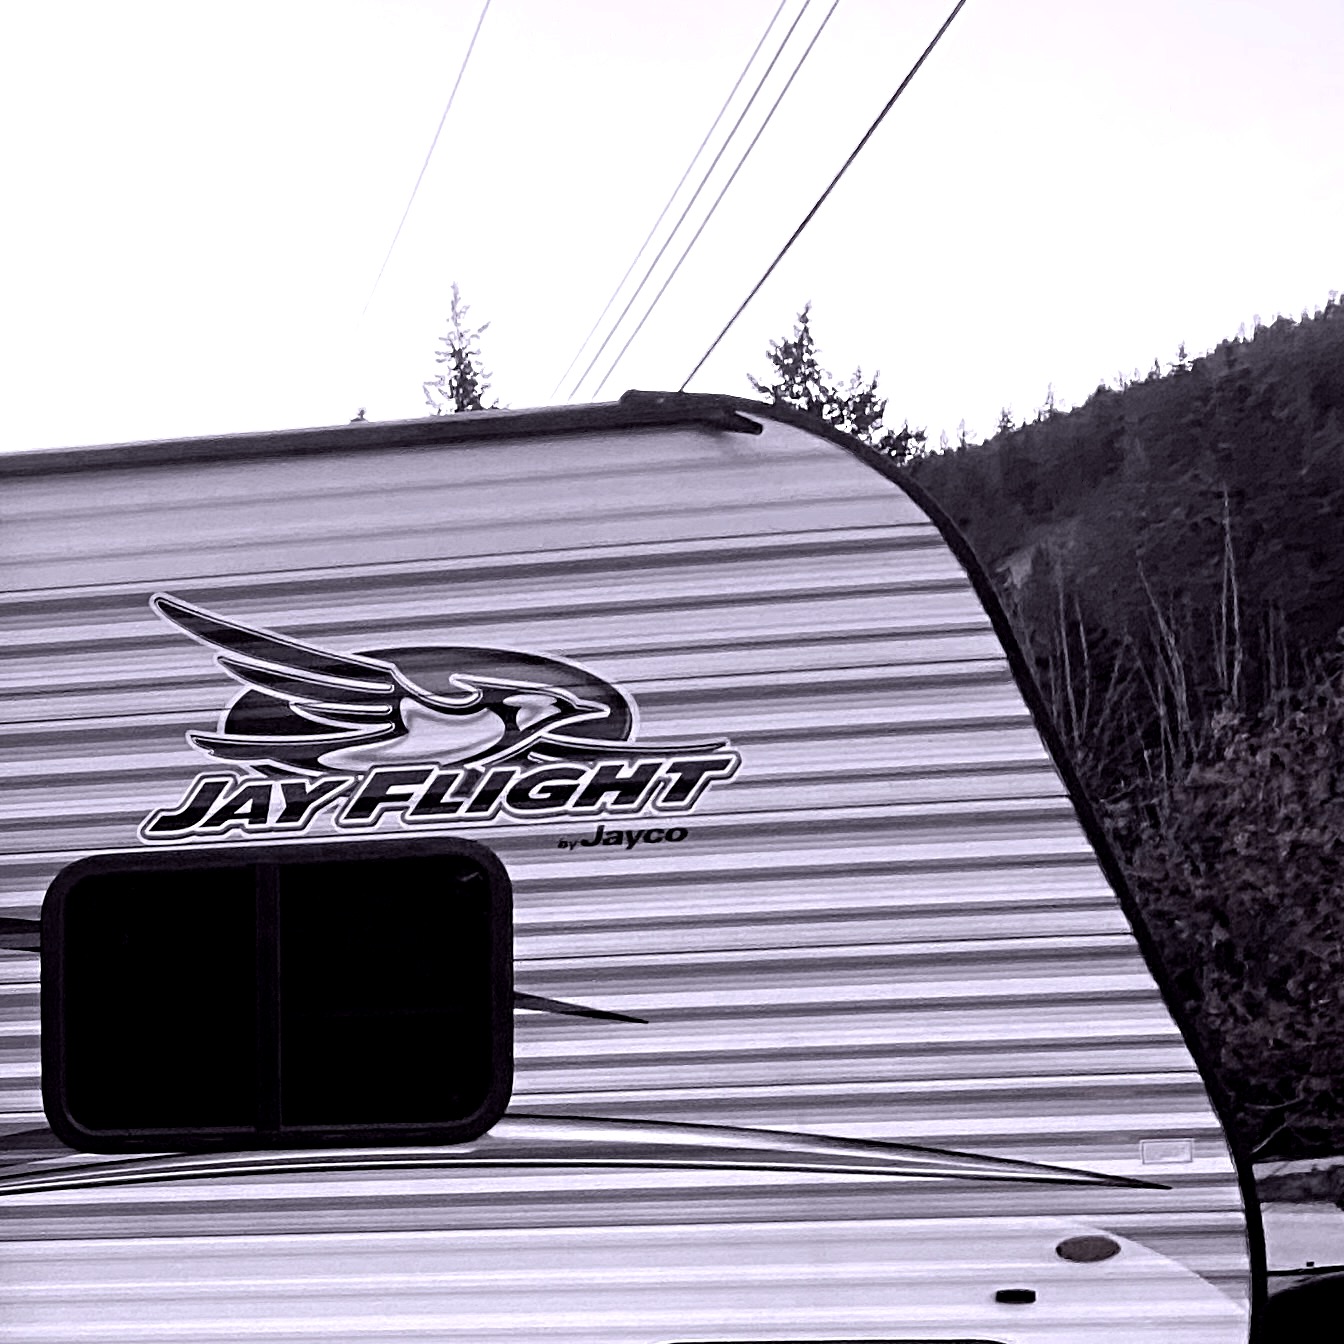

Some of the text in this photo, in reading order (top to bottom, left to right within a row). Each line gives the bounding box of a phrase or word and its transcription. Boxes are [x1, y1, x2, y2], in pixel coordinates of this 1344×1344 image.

[144, 757, 740, 836] JAY FLIGHT
[580, 824, 689, 850] Jayco
